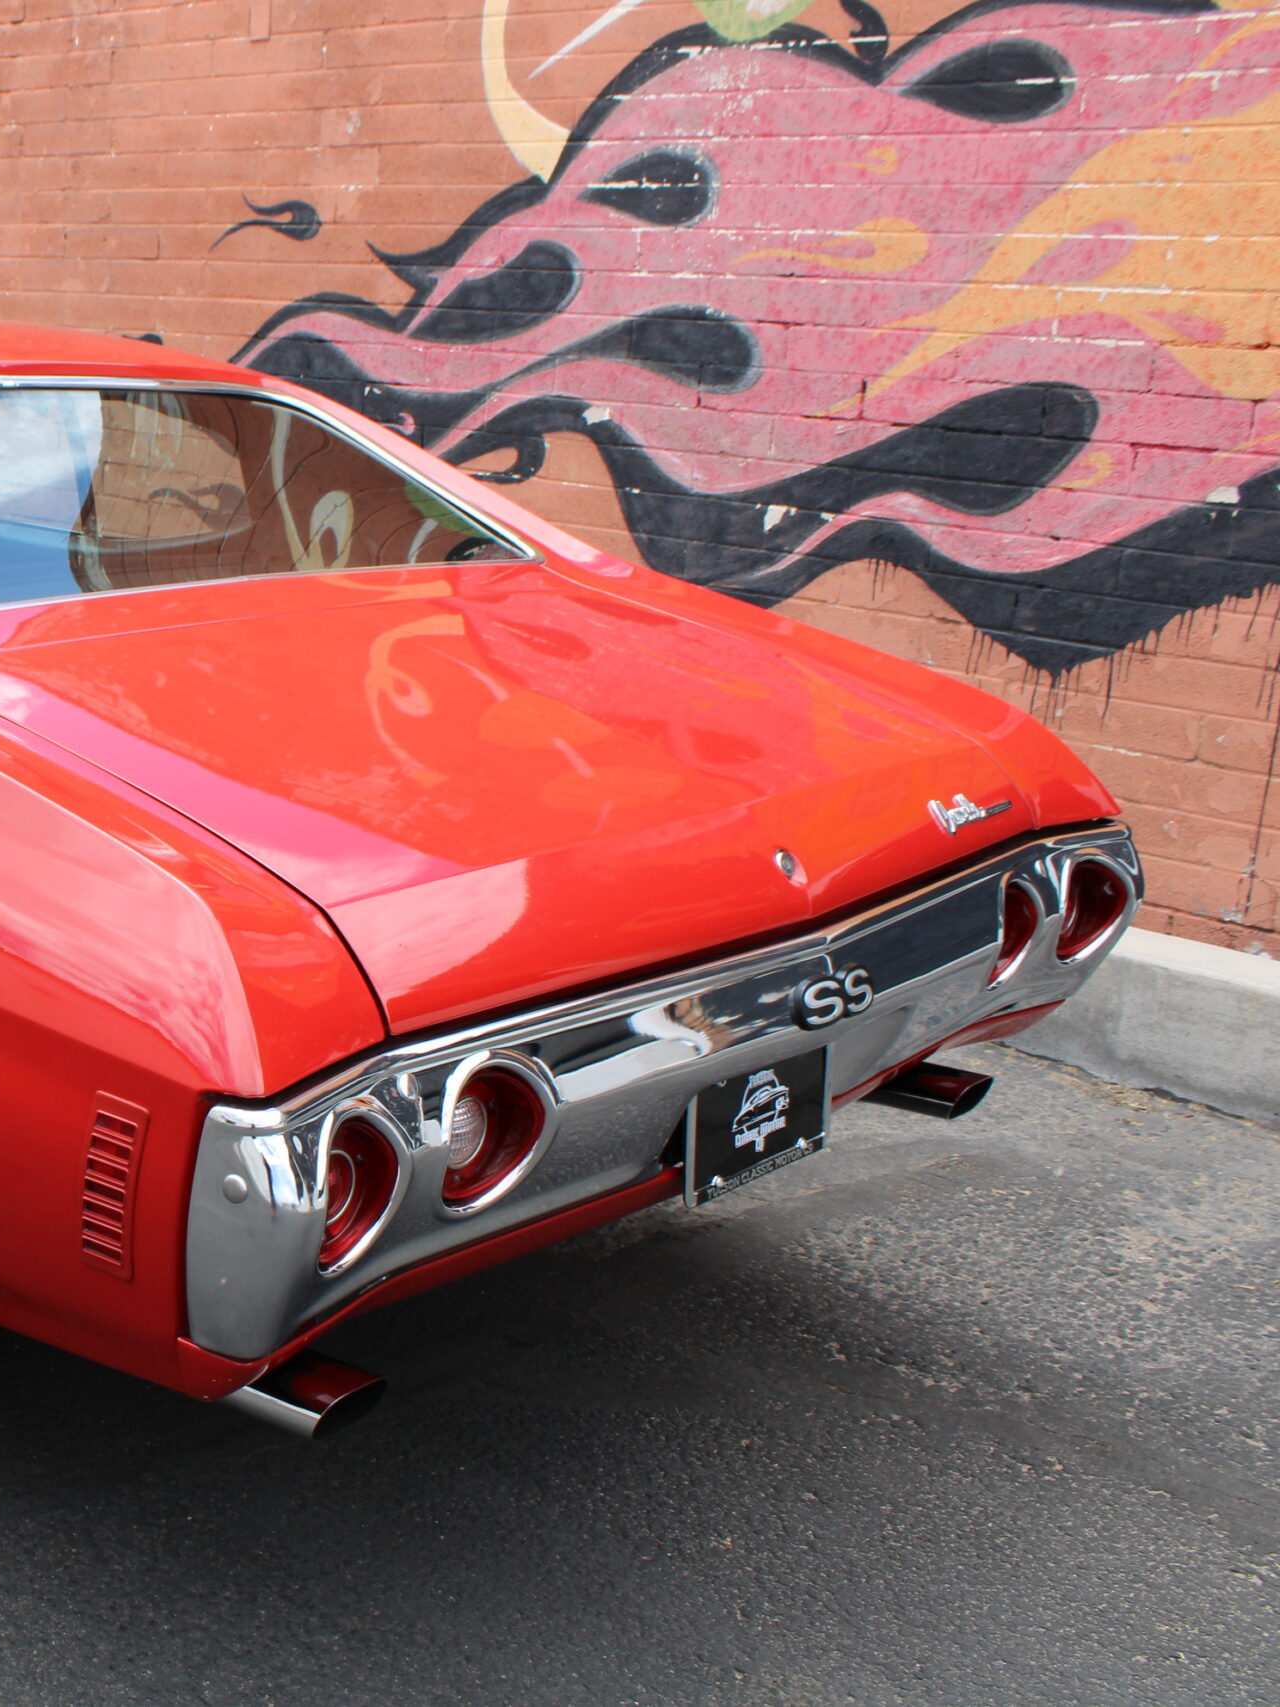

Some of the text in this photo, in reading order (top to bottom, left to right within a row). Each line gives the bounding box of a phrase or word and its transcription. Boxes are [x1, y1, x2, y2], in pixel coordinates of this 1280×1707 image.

[796, 963, 874, 1029] SS
[741, 1160, 774, 1184] CLASSIC
[775, 1149, 802, 1169] MOTOR
